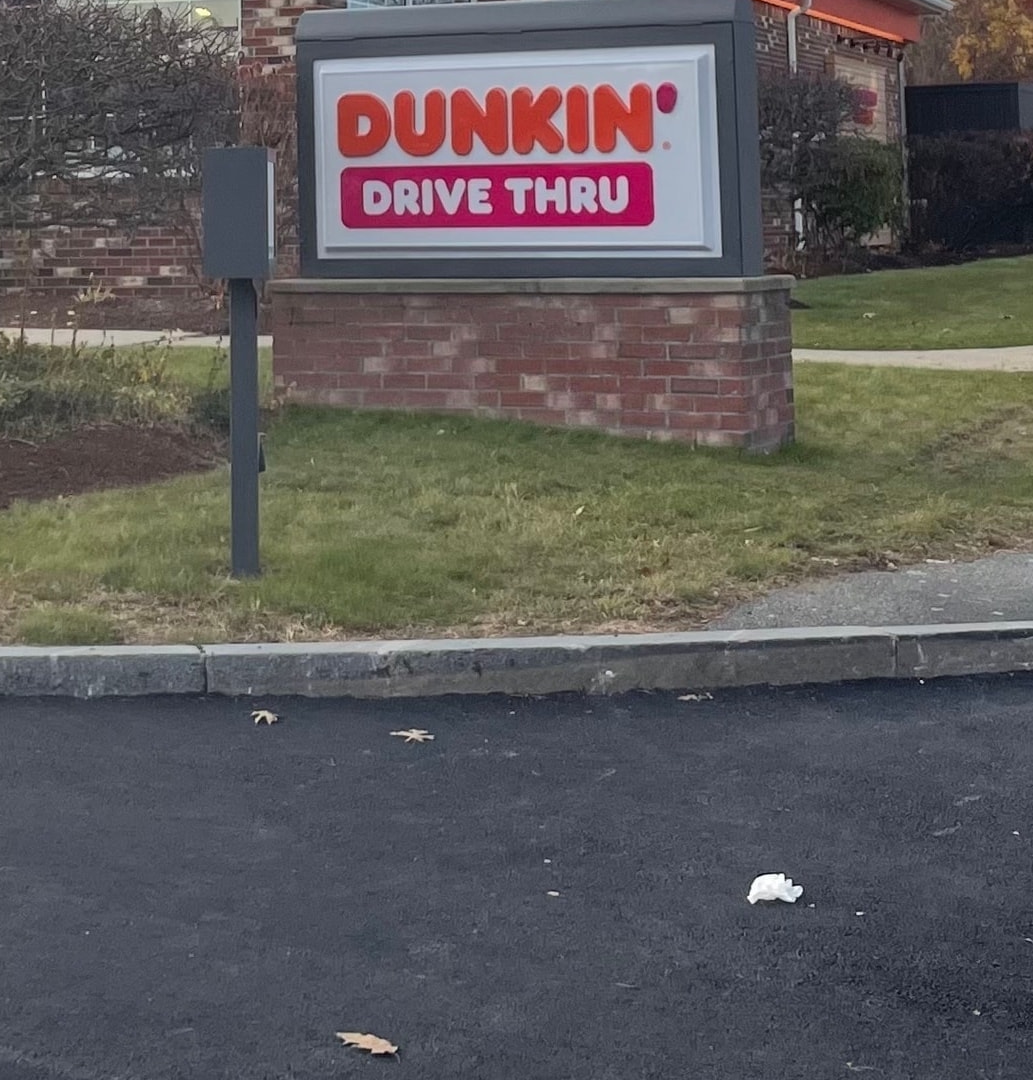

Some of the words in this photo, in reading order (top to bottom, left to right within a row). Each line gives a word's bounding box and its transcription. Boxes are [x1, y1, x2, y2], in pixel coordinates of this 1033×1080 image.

[337, 82, 678, 158] DUNKIN'
[362, 177, 493, 216] DRIVE
[504, 175, 629, 215] THRU
